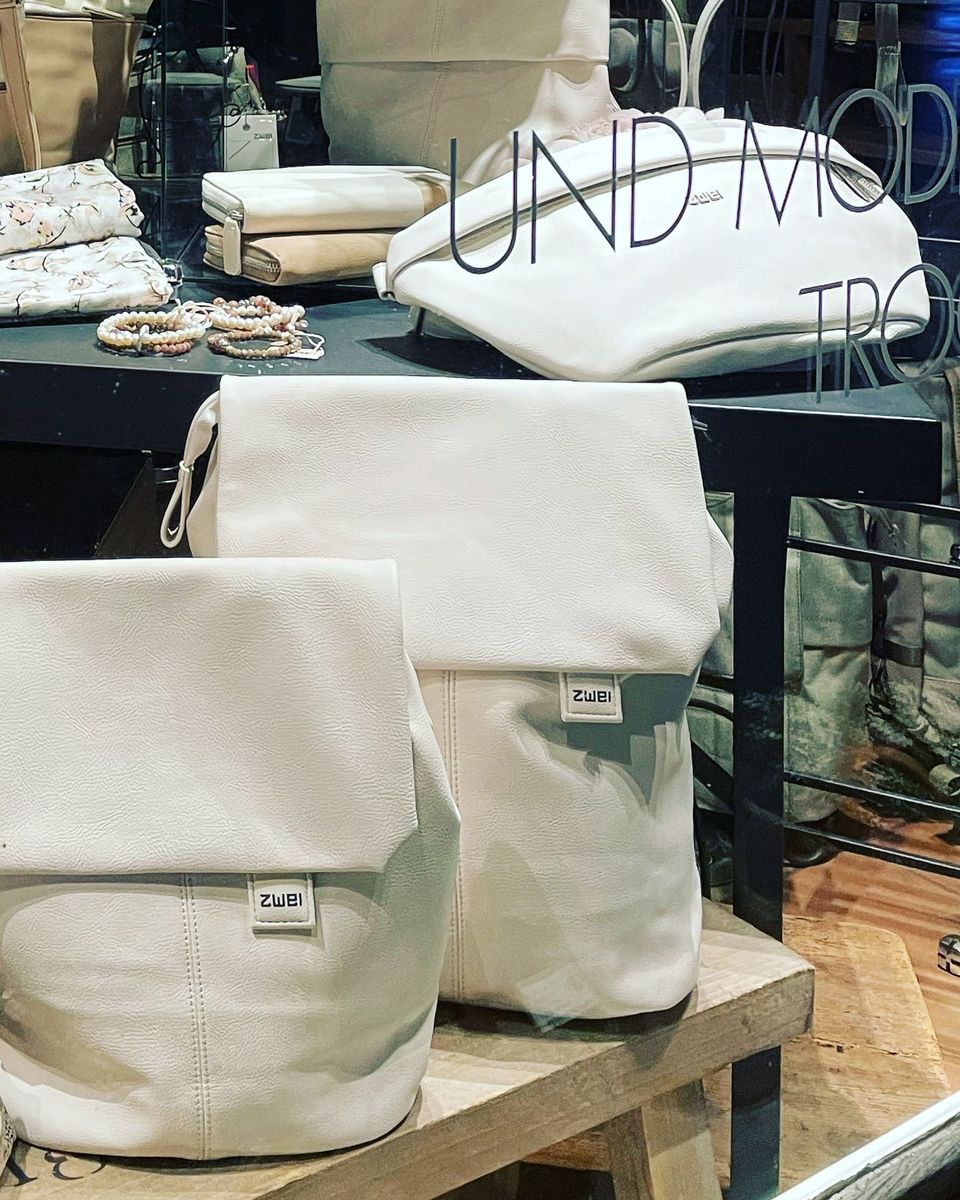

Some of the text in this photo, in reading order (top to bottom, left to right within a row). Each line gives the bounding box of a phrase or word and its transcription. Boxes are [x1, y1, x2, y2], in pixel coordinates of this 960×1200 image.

[450, 83, 960, 275] UND MOD
[798, 262, 960, 404] TRO
